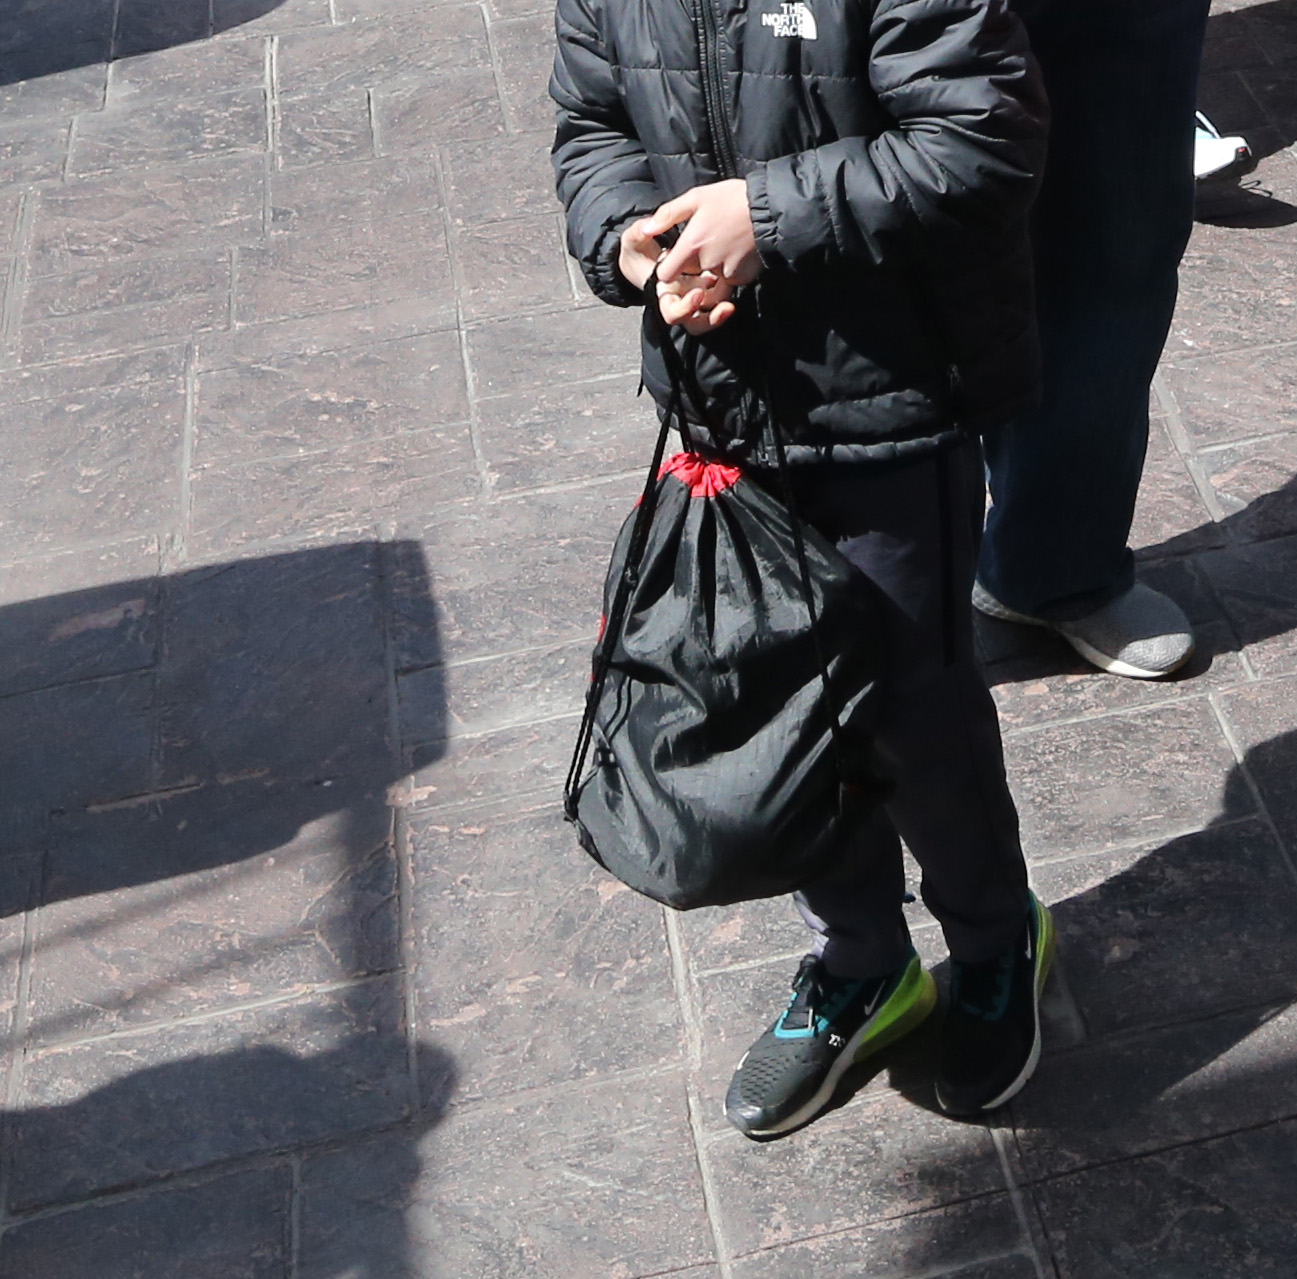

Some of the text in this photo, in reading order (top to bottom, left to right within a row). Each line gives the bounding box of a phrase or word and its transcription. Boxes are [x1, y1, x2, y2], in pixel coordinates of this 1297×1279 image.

[780, 2, 805, 15] THE
[762, 13, 804, 26] NORTH
[774, 25, 804, 38] FACE
